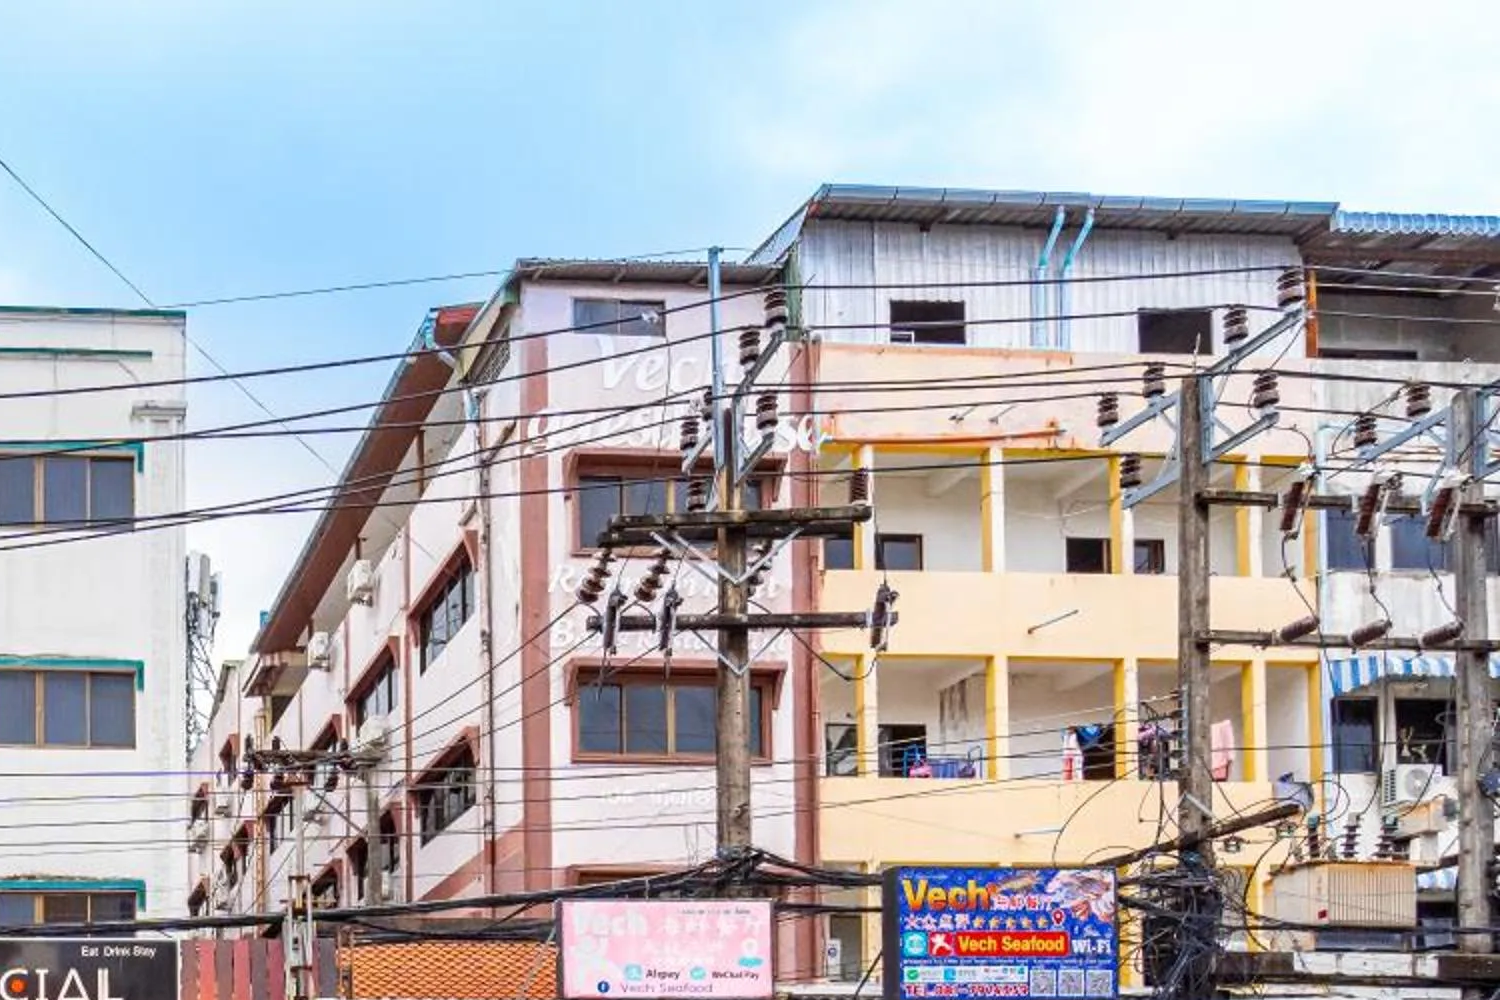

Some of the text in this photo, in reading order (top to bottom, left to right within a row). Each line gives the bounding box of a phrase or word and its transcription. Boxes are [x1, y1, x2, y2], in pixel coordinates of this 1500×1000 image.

[902, 878, 990, 911] Vech
[81, 945, 100, 957] Eat
[103, 945, 131, 957] Drink
[957, 935, 1065, 953] Vech Seafood
